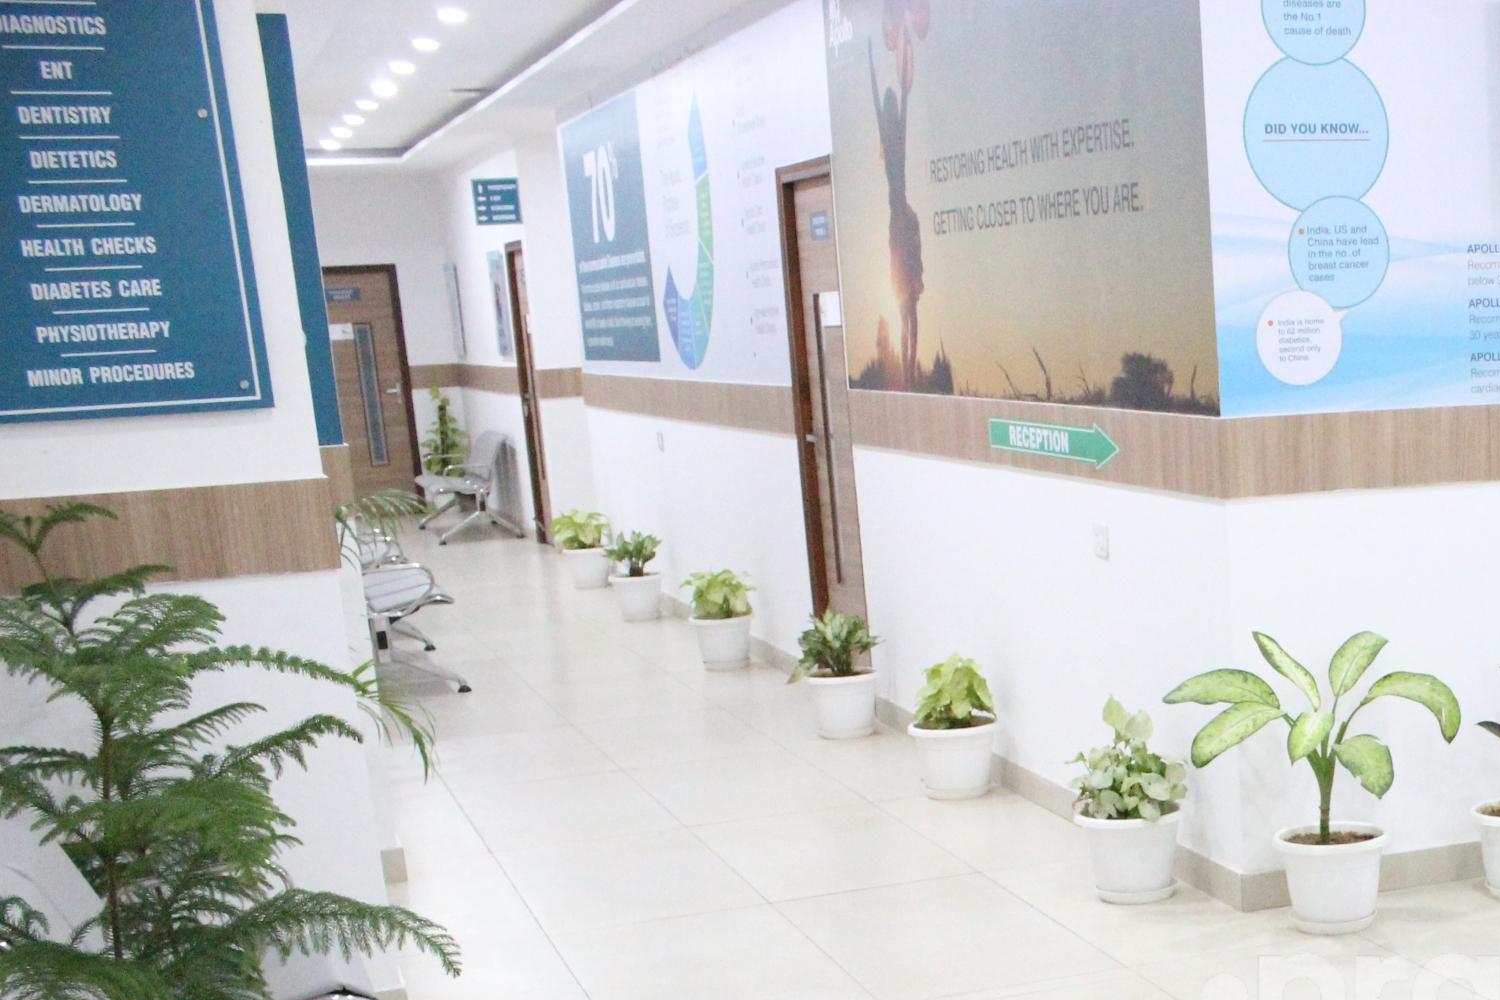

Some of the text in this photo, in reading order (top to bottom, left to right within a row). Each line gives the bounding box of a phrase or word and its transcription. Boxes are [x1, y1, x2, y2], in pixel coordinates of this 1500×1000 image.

[1283, 12, 1298, 21] the
[1284, 26, 1352, 36] cause of death
[40, 61, 73, 79] ENT
[17, 106, 111, 124] DENTISTRY
[1264, 123, 1369, 134] DID YOU KNOW...
[29, 150, 118, 169] DIETETICS
[929, 119, 1135, 183] RESTORING HEALTH WITH EXPERTISE.
[18, 194, 142, 213] DERMATOLOGY
[933, 182, 1144, 236] GETTING CLOSER TO WHERE YOU ARE.
[1334, 225, 1348, 234] US
[1350, 224, 1367, 233] and
[20, 236, 157, 257] HEALTH CHECKS
[1308, 237, 1379, 247] China have lead
[1308, 249, 1316, 258] in
[1318, 249, 1333, 257] the
[1352, 249, 1361, 257] of
[1308, 261, 1369, 270] breast cancer
[30, 279, 162, 300] DIABETES CARE
[36, 321, 170, 343] PHYSIOTHERAPY
[27, 362, 195, 387] MINOR PROCEDURES
[1008, 425, 1069, 454] RECEPTION
